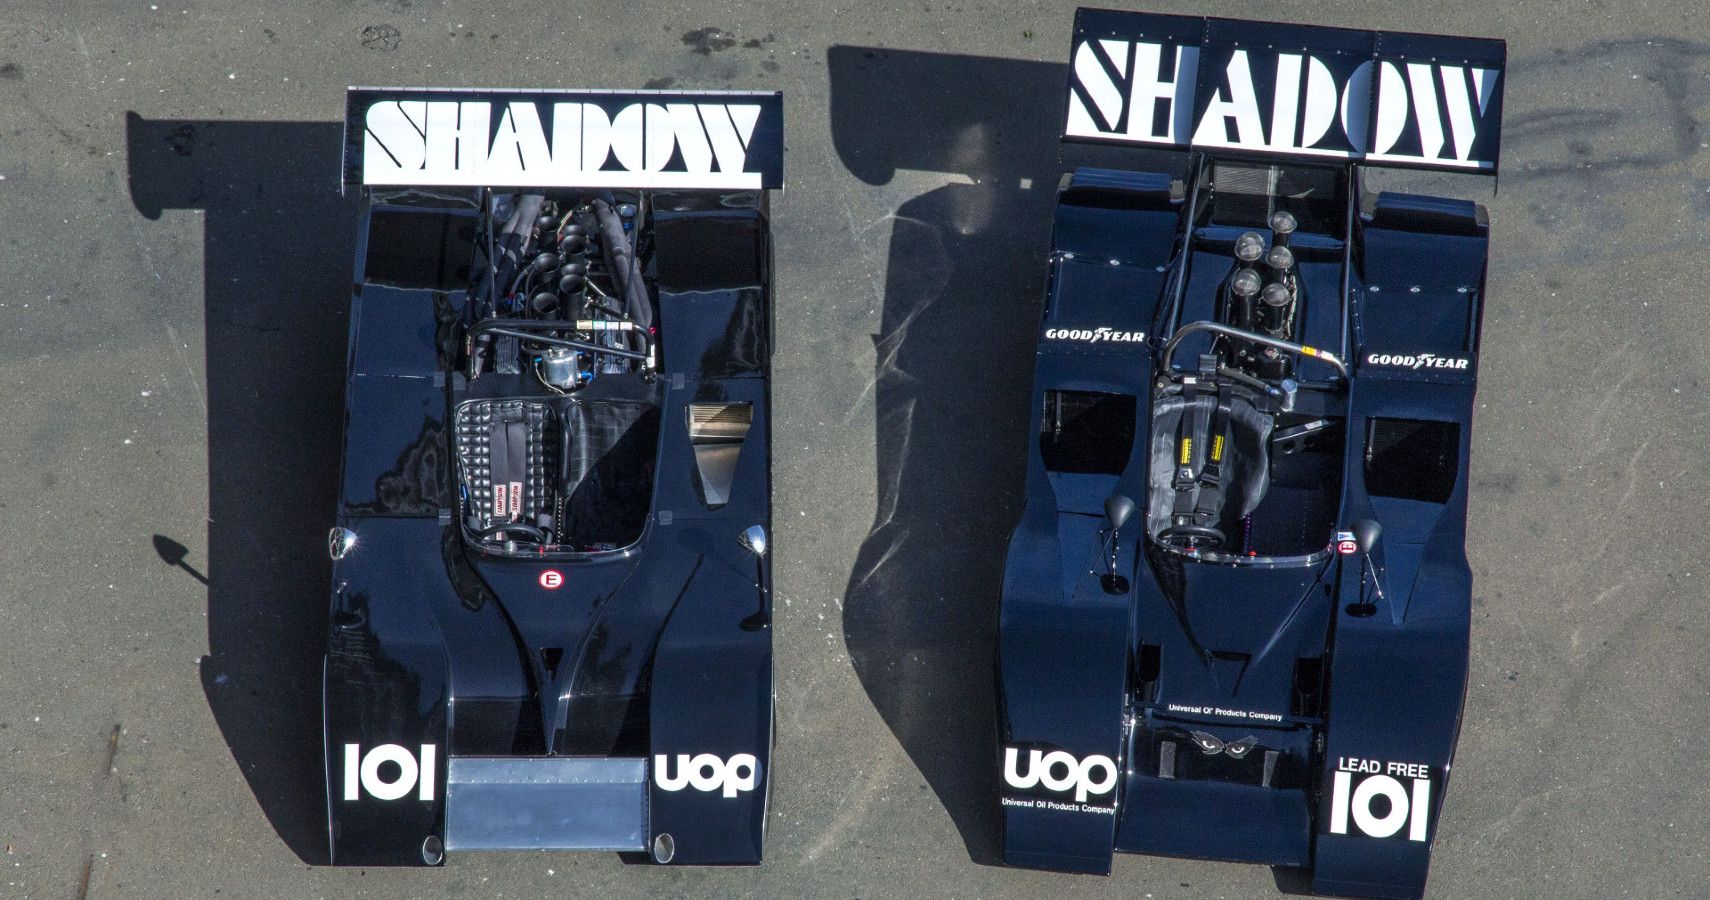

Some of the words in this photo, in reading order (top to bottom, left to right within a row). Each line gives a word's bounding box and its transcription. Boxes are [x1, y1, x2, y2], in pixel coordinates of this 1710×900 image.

[1065, 39, 1500, 169] SHADOW
[363, 100, 763, 189] SHADOW
[1045, 327, 1145, 343] GOODYEAR
[1368, 354, 1469, 370] GOODYEAR
[545, 574, 558, 586] E
[1168, 704, 1201, 713] Universal
[1215, 708, 1247, 717] Products
[1249, 711, 1283, 722] Company
[344, 743, 436, 801] 101
[1339, 757, 1381, 774] LEAD
[1387, 761, 1429, 779] FREE
[1001, 797, 1034, 807] Universal
[1036, 801, 1046, 809] Oil
[1048, 802, 1080, 812] Products
[1081, 804, 1115, 815] Company
[1330, 770, 1431, 842] 101
